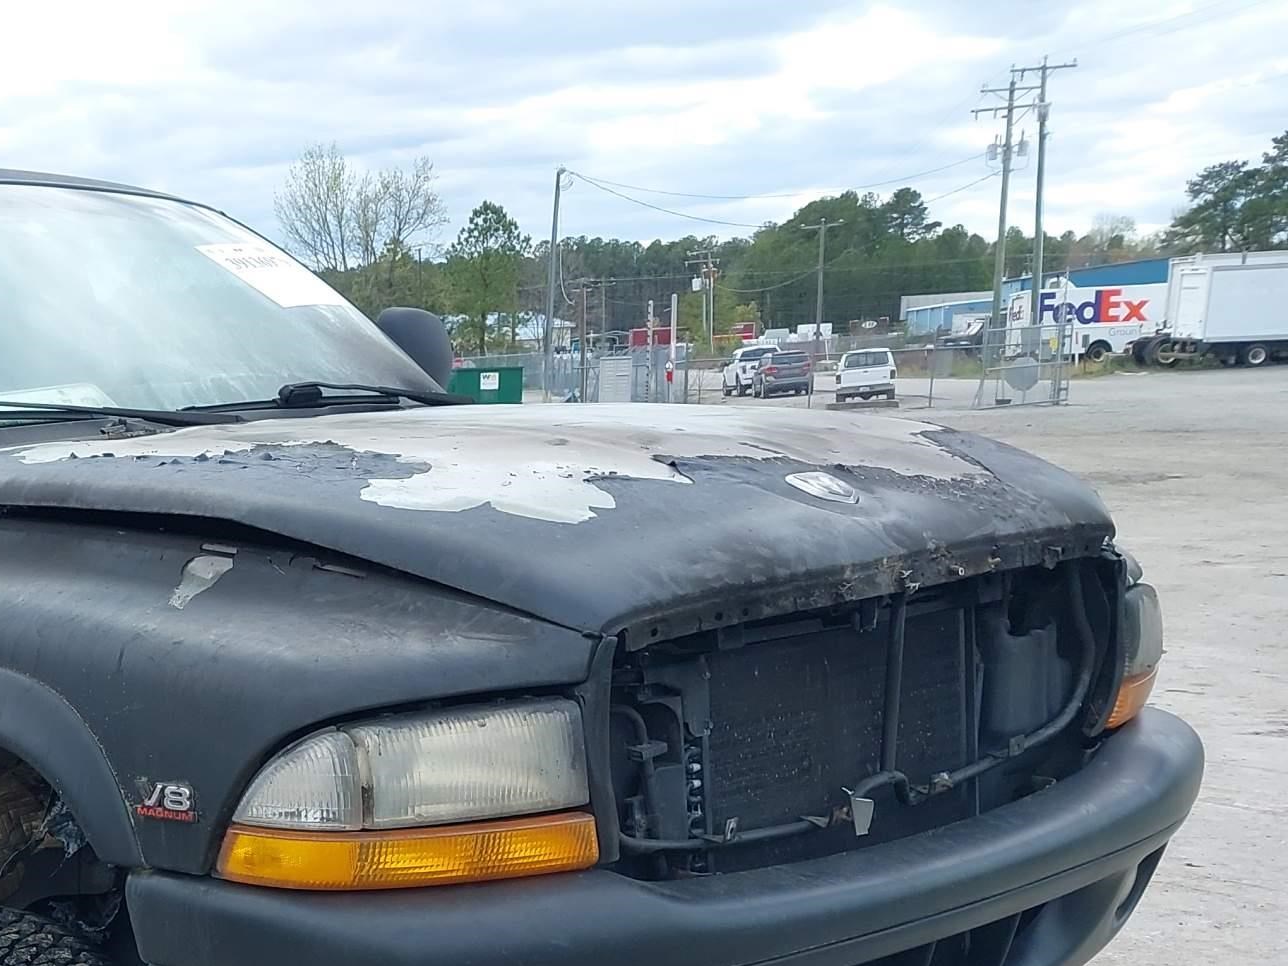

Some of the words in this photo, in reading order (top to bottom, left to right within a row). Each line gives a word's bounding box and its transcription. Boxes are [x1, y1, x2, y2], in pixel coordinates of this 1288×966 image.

[1040, 289, 1150, 325] FedEx
[1109, 327, 1139, 337] Groun
[138, 780, 191, 811] V8
[136, 806, 195, 823] MAGNUM
